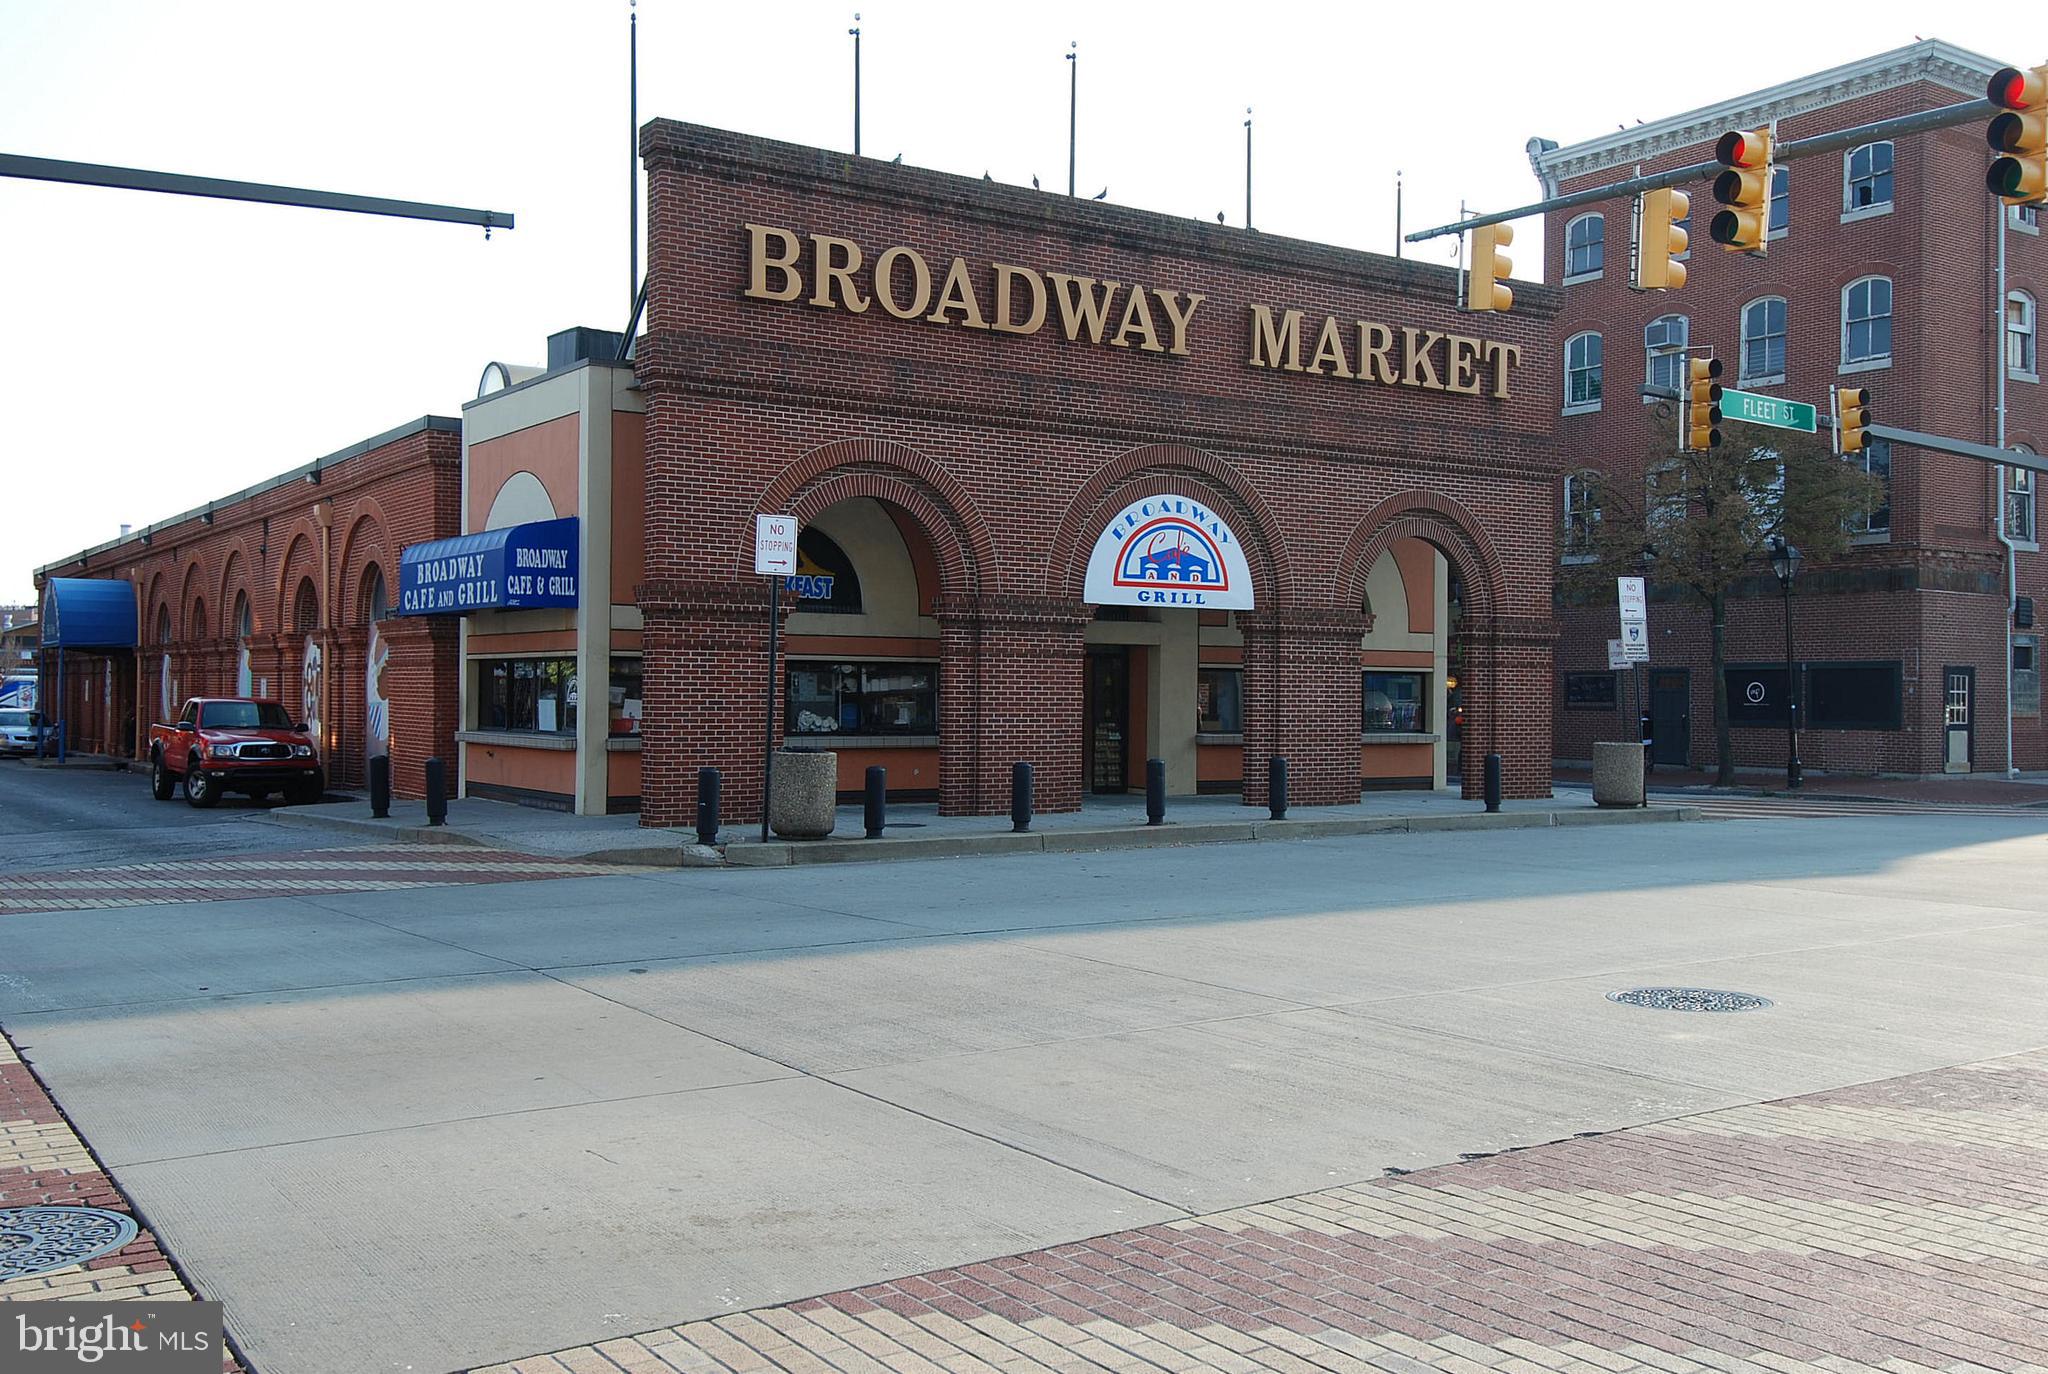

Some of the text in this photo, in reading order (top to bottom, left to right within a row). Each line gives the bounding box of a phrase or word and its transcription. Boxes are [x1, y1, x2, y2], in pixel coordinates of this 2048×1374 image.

[744, 223, 1521, 399] BROADWAY MARKET
[1743, 398, 1795, 421] FLEET ST
[770, 524, 785, 536] NO
[1112, 500, 1232, 545] BROADWAY
[760, 540, 793, 553] STOPPING
[516, 548, 568, 569] BROADWAY
[417, 554, 484, 585] BROADWAY
[404, 580, 498, 610] CAFE AND GRILL
[507, 575, 576, 596] CAFE & GRILL
[1626, 583, 1637, 592] NO
[1137, 590, 1206, 605] GRILL
